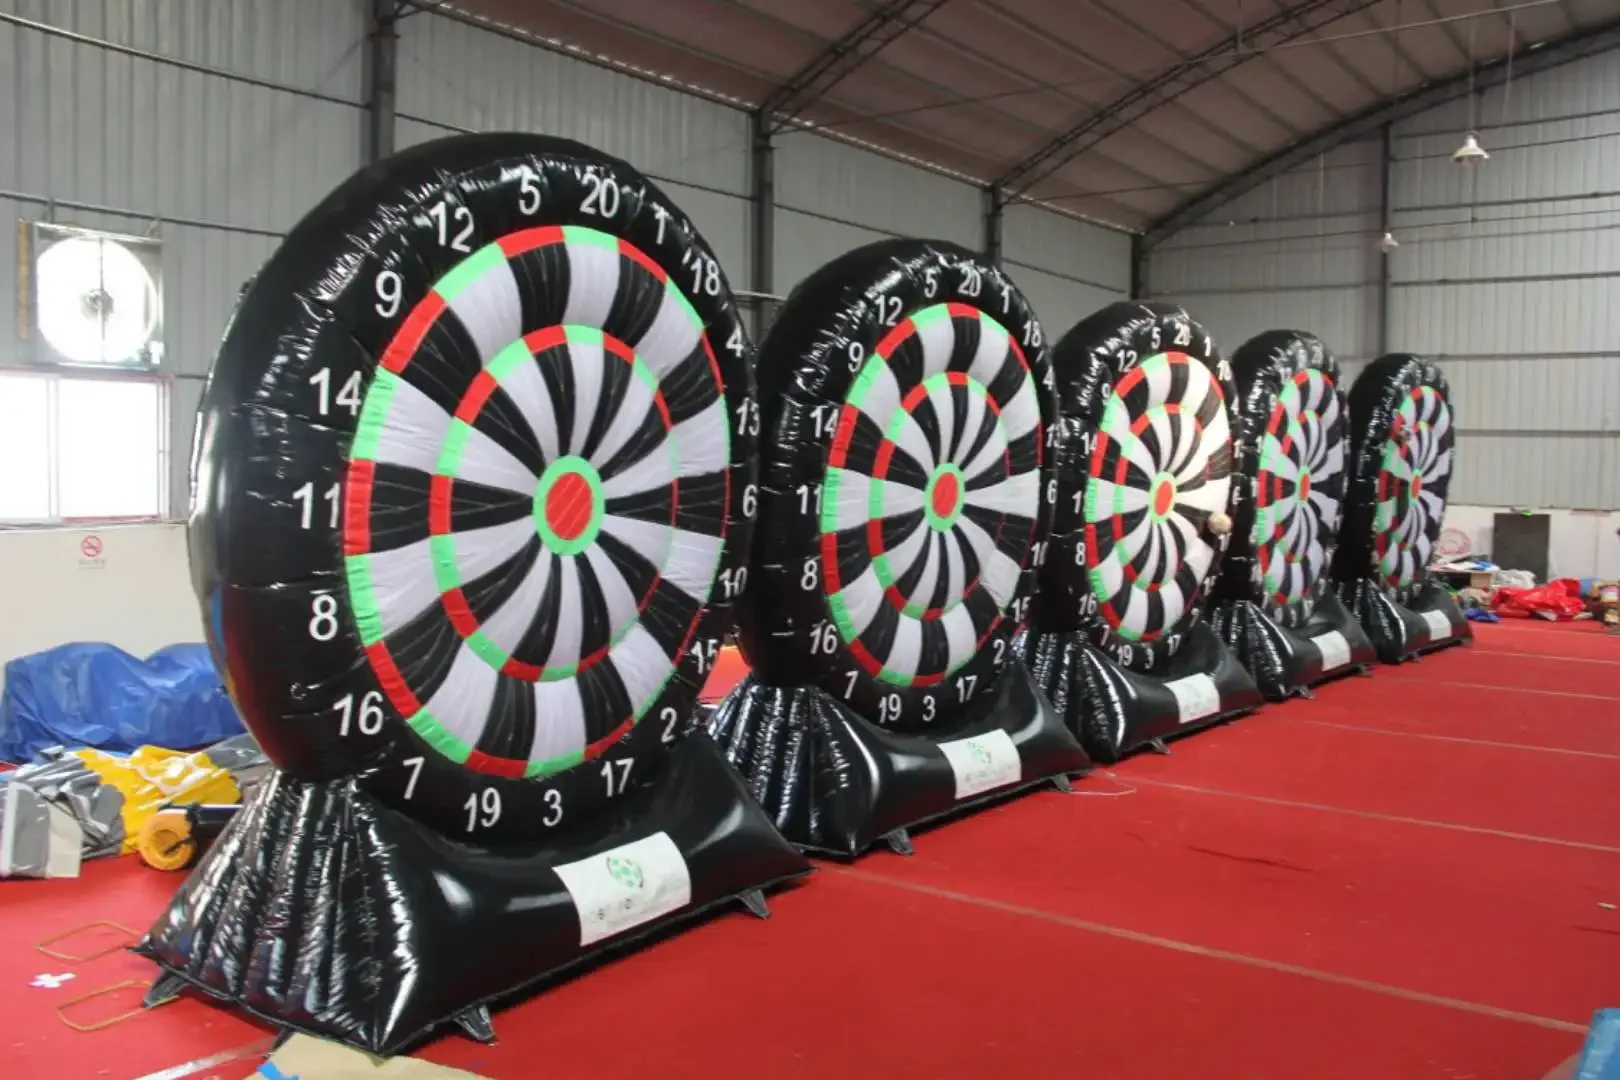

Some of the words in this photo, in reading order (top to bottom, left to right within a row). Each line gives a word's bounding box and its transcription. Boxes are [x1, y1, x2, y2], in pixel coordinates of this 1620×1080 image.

[518, 167, 540, 215] 5
[581, 172, 619, 219] 20
[430, 201, 475, 252] 12
[654, 205, 669, 244] 1
[691, 256, 720, 296] 18
[924, 269, 937, 297] 5
[958, 269, 982, 296] 20
[375, 271, 402, 318] 9
[1001, 285, 1013, 313] 1
[875, 296, 903, 325] 12
[726, 323, 743, 357] 4
[1023, 320, 1041, 346] 18
[1151, 327, 1161, 349] 5
[847, 342, 863, 372] 9
[1116, 350, 1137, 372] 12
[309, 368, 361, 416] 14
[1042, 365, 1053, 390] 4
[1102, 383, 1112, 405] 9
[810, 405, 838, 438] 14
[293, 482, 341, 529] 11
[742, 484, 757, 517] 6
[796, 485, 822, 514] 11
[1047, 480, 1057, 504] 6
[1075, 542, 1085, 565] 8
[719, 568, 747, 597] 10
[801, 560, 817, 590] 8
[309, 595, 338, 641] 8
[1012, 597, 1030, 623] 15
[1079, 593, 1097, 615] 16
[810, 625, 837, 655] 16
[1100, 625, 1110, 646] 7
[1168, 635, 1181, 656] 17
[692, 639, 717, 674] 15
[993, 639, 1005, 664] 2
[1117, 645, 1133, 667] 19
[844, 670, 858, 699] 7
[956, 675, 978, 702] 17
[334, 691, 383, 735] 16
[878, 693, 901, 722] 19
[922, 695, 936, 721] 3
[660, 708, 677, 742] 2
[403, 756, 425, 799] 7
[600, 758, 634, 796] 17
[464, 788, 501, 831] 19
[543, 790, 562, 826] 3
